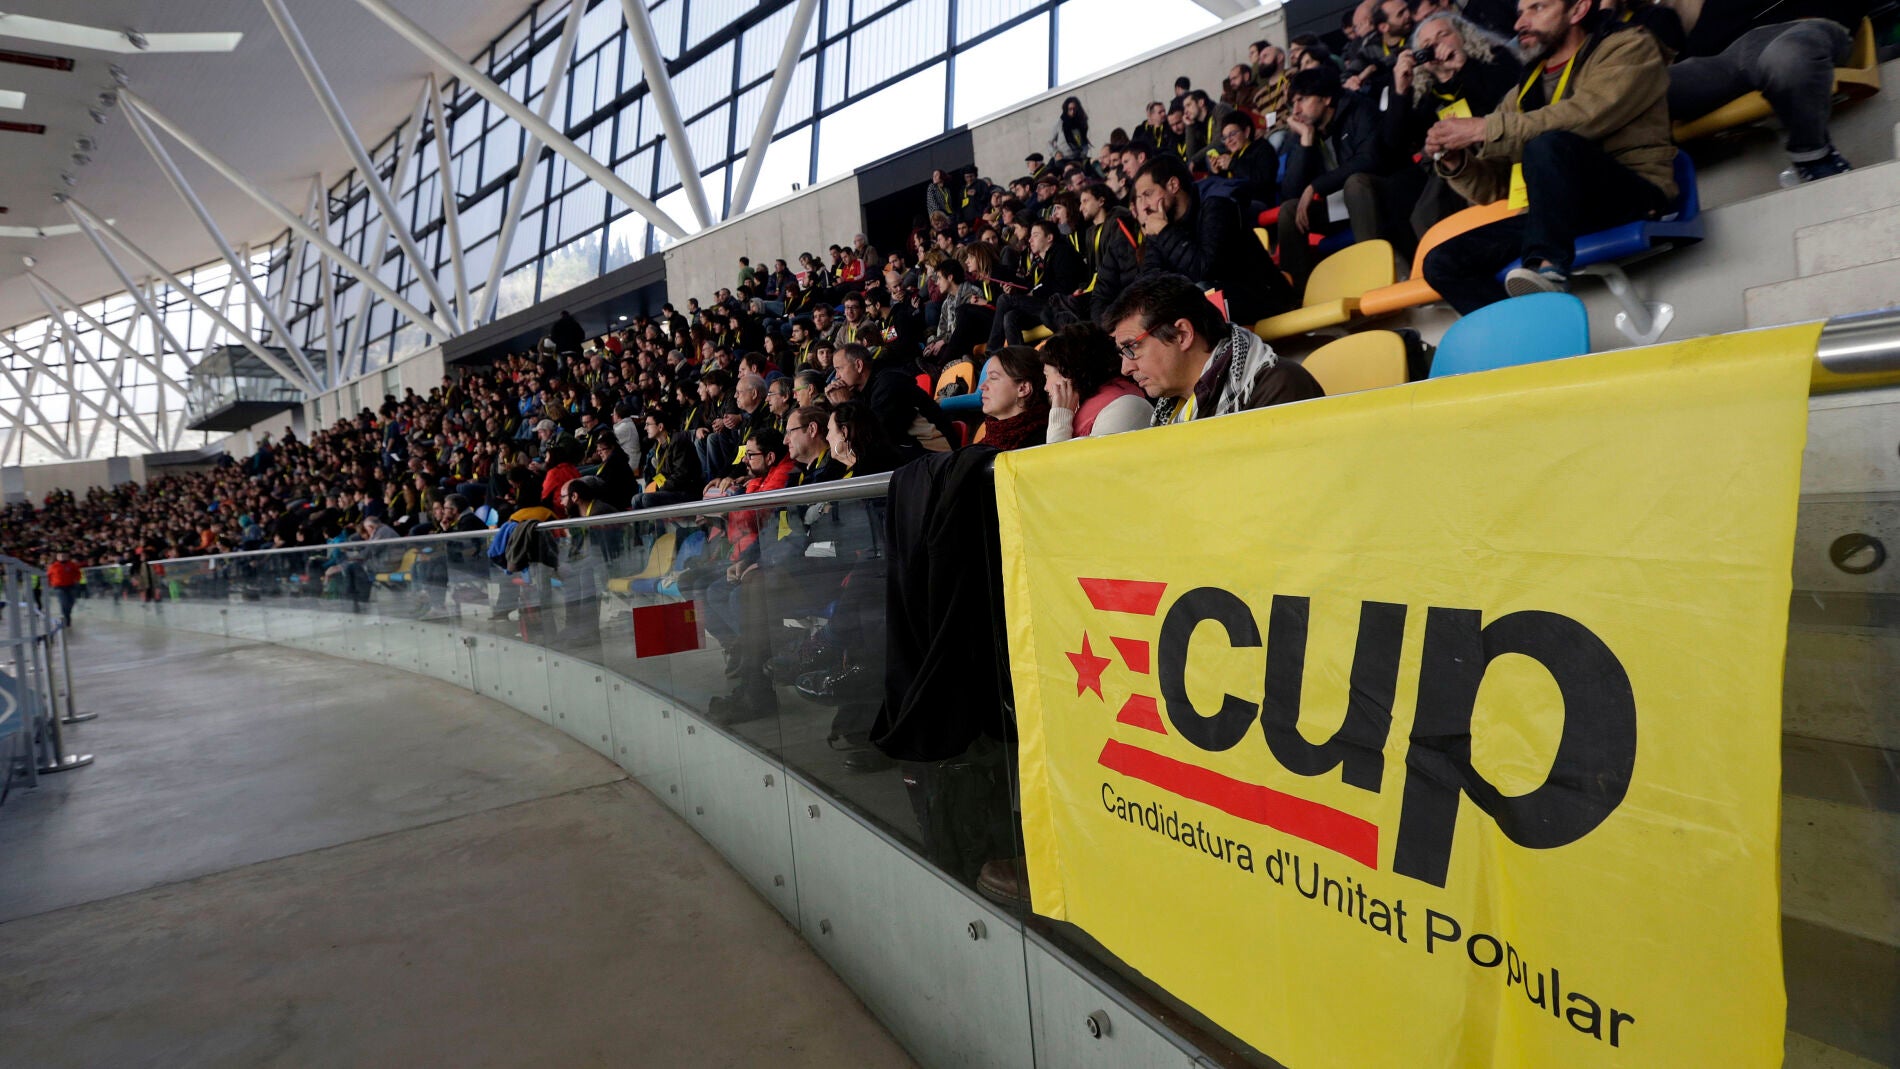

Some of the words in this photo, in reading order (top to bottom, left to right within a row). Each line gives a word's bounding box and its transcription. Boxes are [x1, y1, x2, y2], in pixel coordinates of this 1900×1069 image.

[1157, 586, 1638, 889] cup
[1100, 782, 1254, 874] Candidatura
[1265, 848, 1408, 944] d'Unitat
[1425, 908, 1637, 1050] Popular
